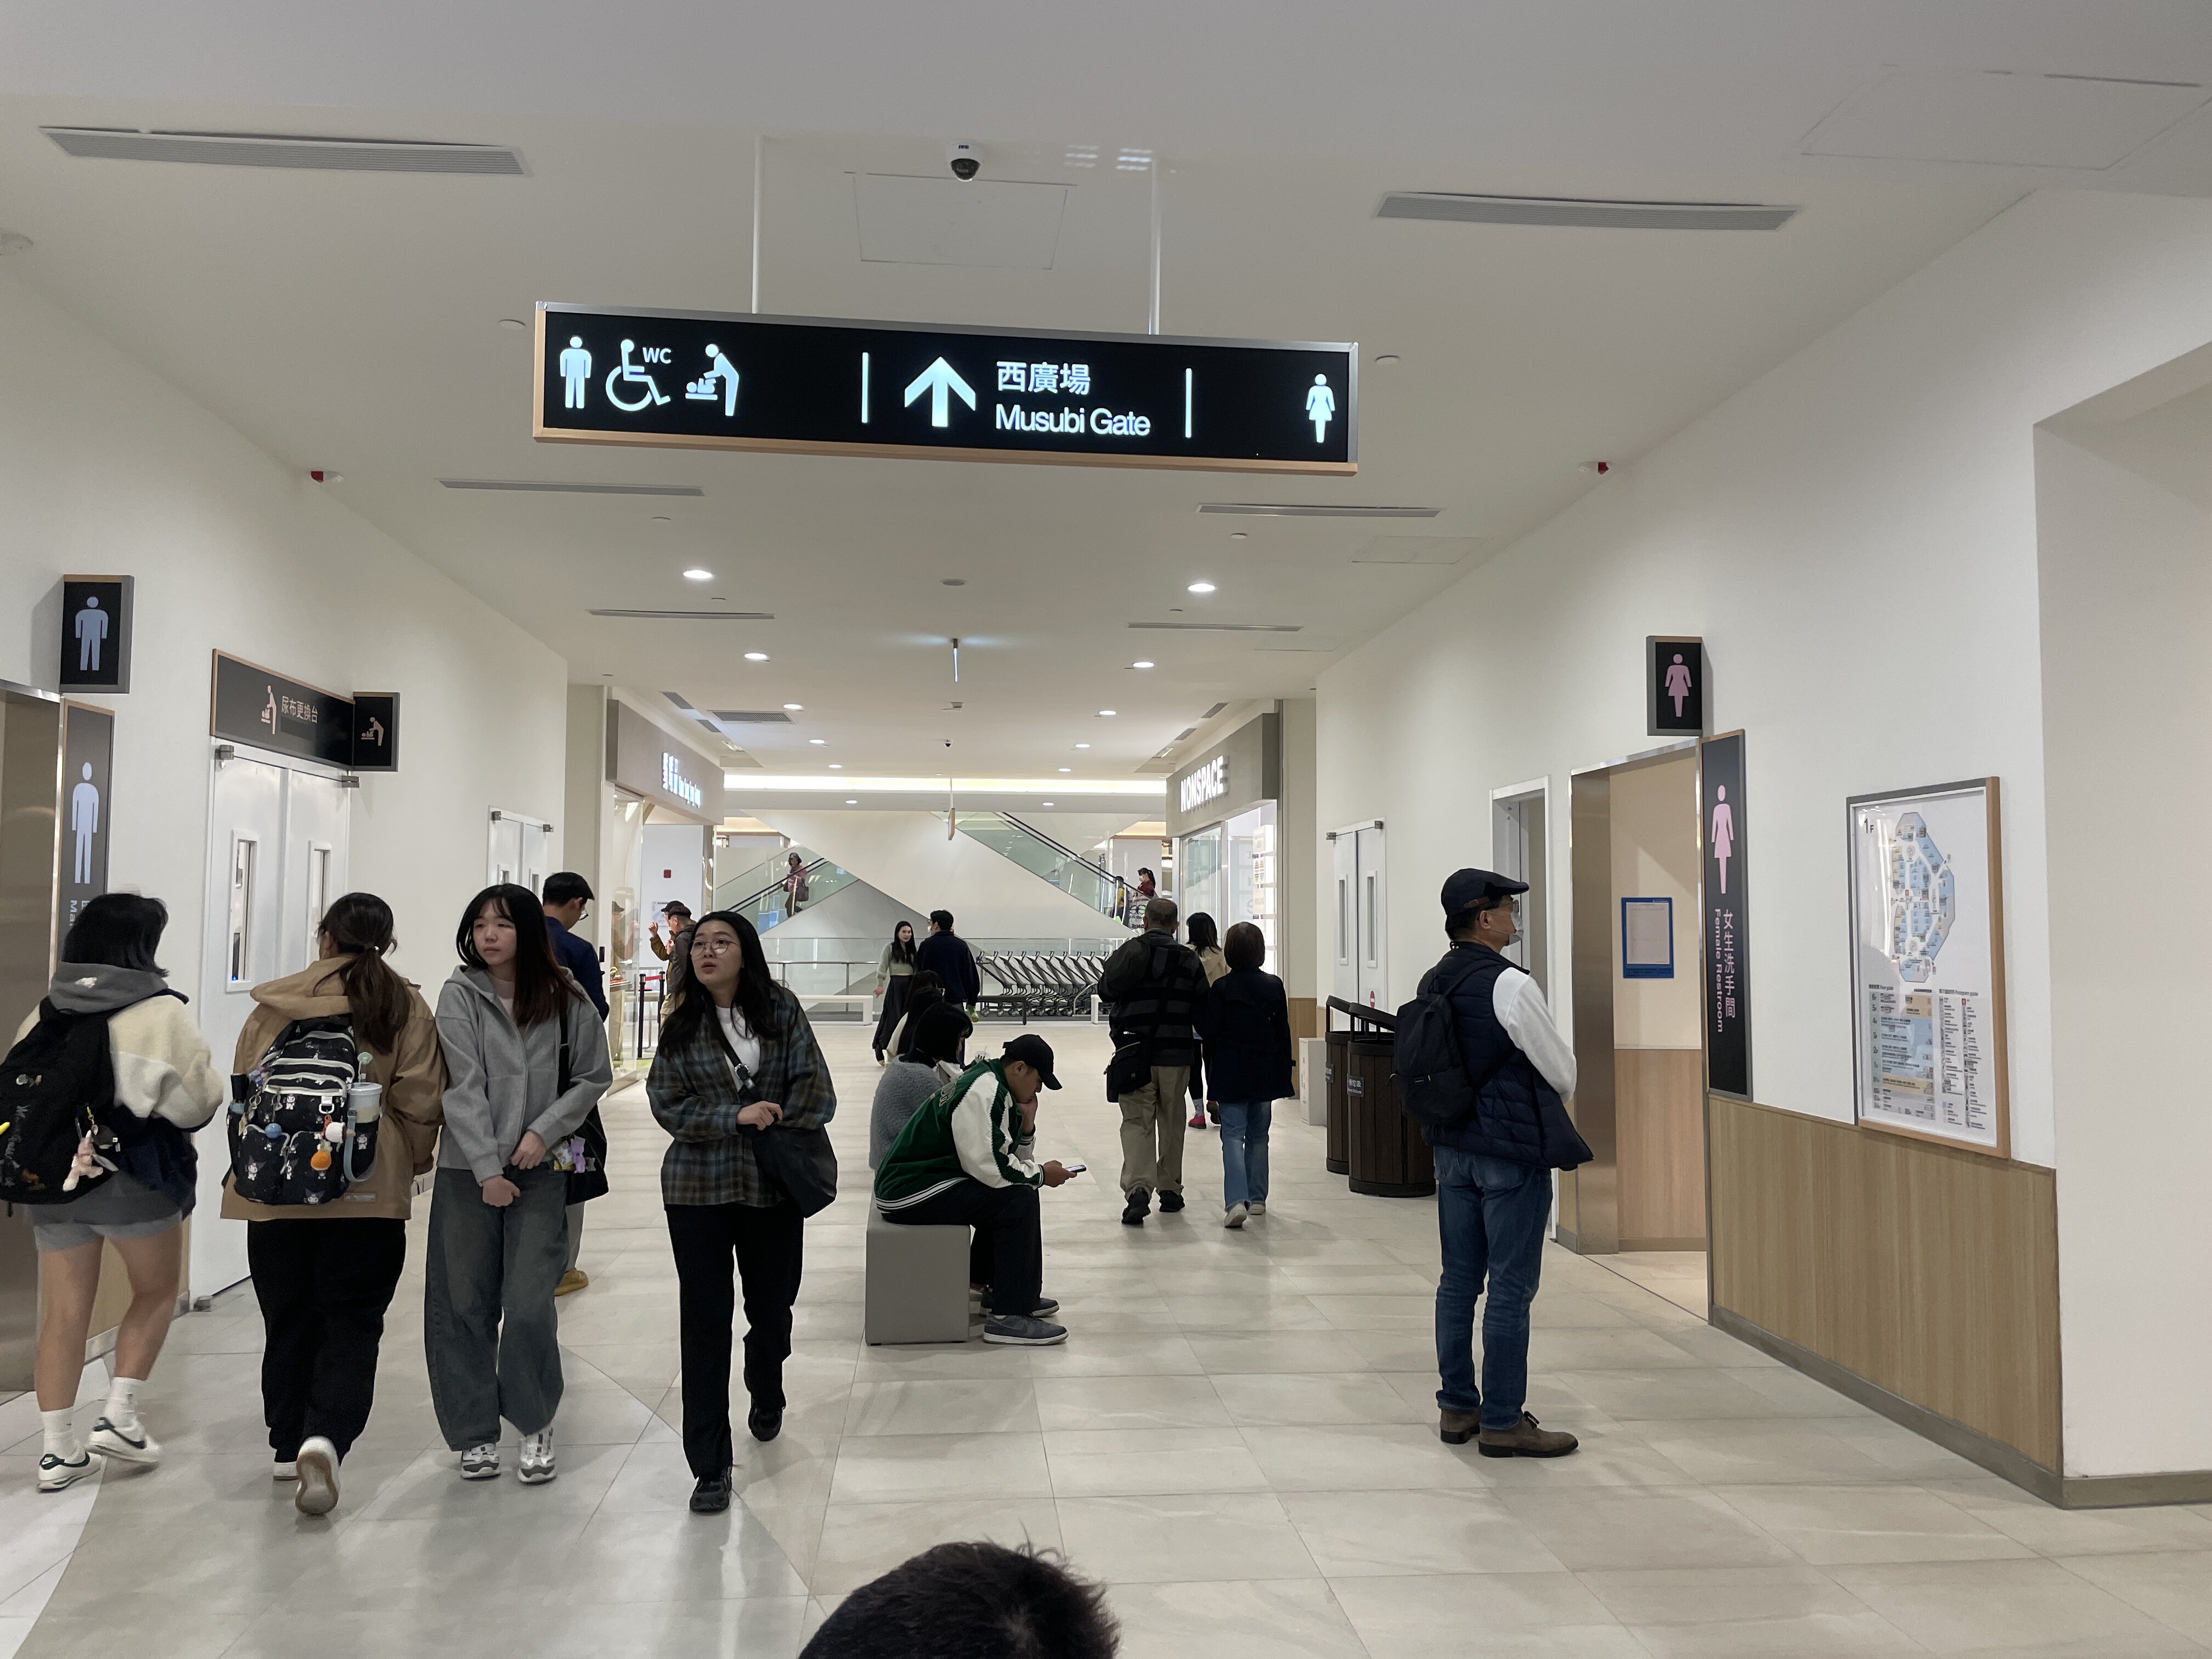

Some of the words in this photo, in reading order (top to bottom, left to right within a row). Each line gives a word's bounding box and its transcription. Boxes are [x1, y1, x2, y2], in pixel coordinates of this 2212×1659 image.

[642, 347, 672, 364] WC
[996, 360, 1091, 396] 西廣場
[995, 403, 1085, 433] Musubi
[1090, 407, 1151, 436] Gate
[1181, 755, 1224, 812] NONSPACE
[1723, 909, 1736, 1018] 女生洗手間
